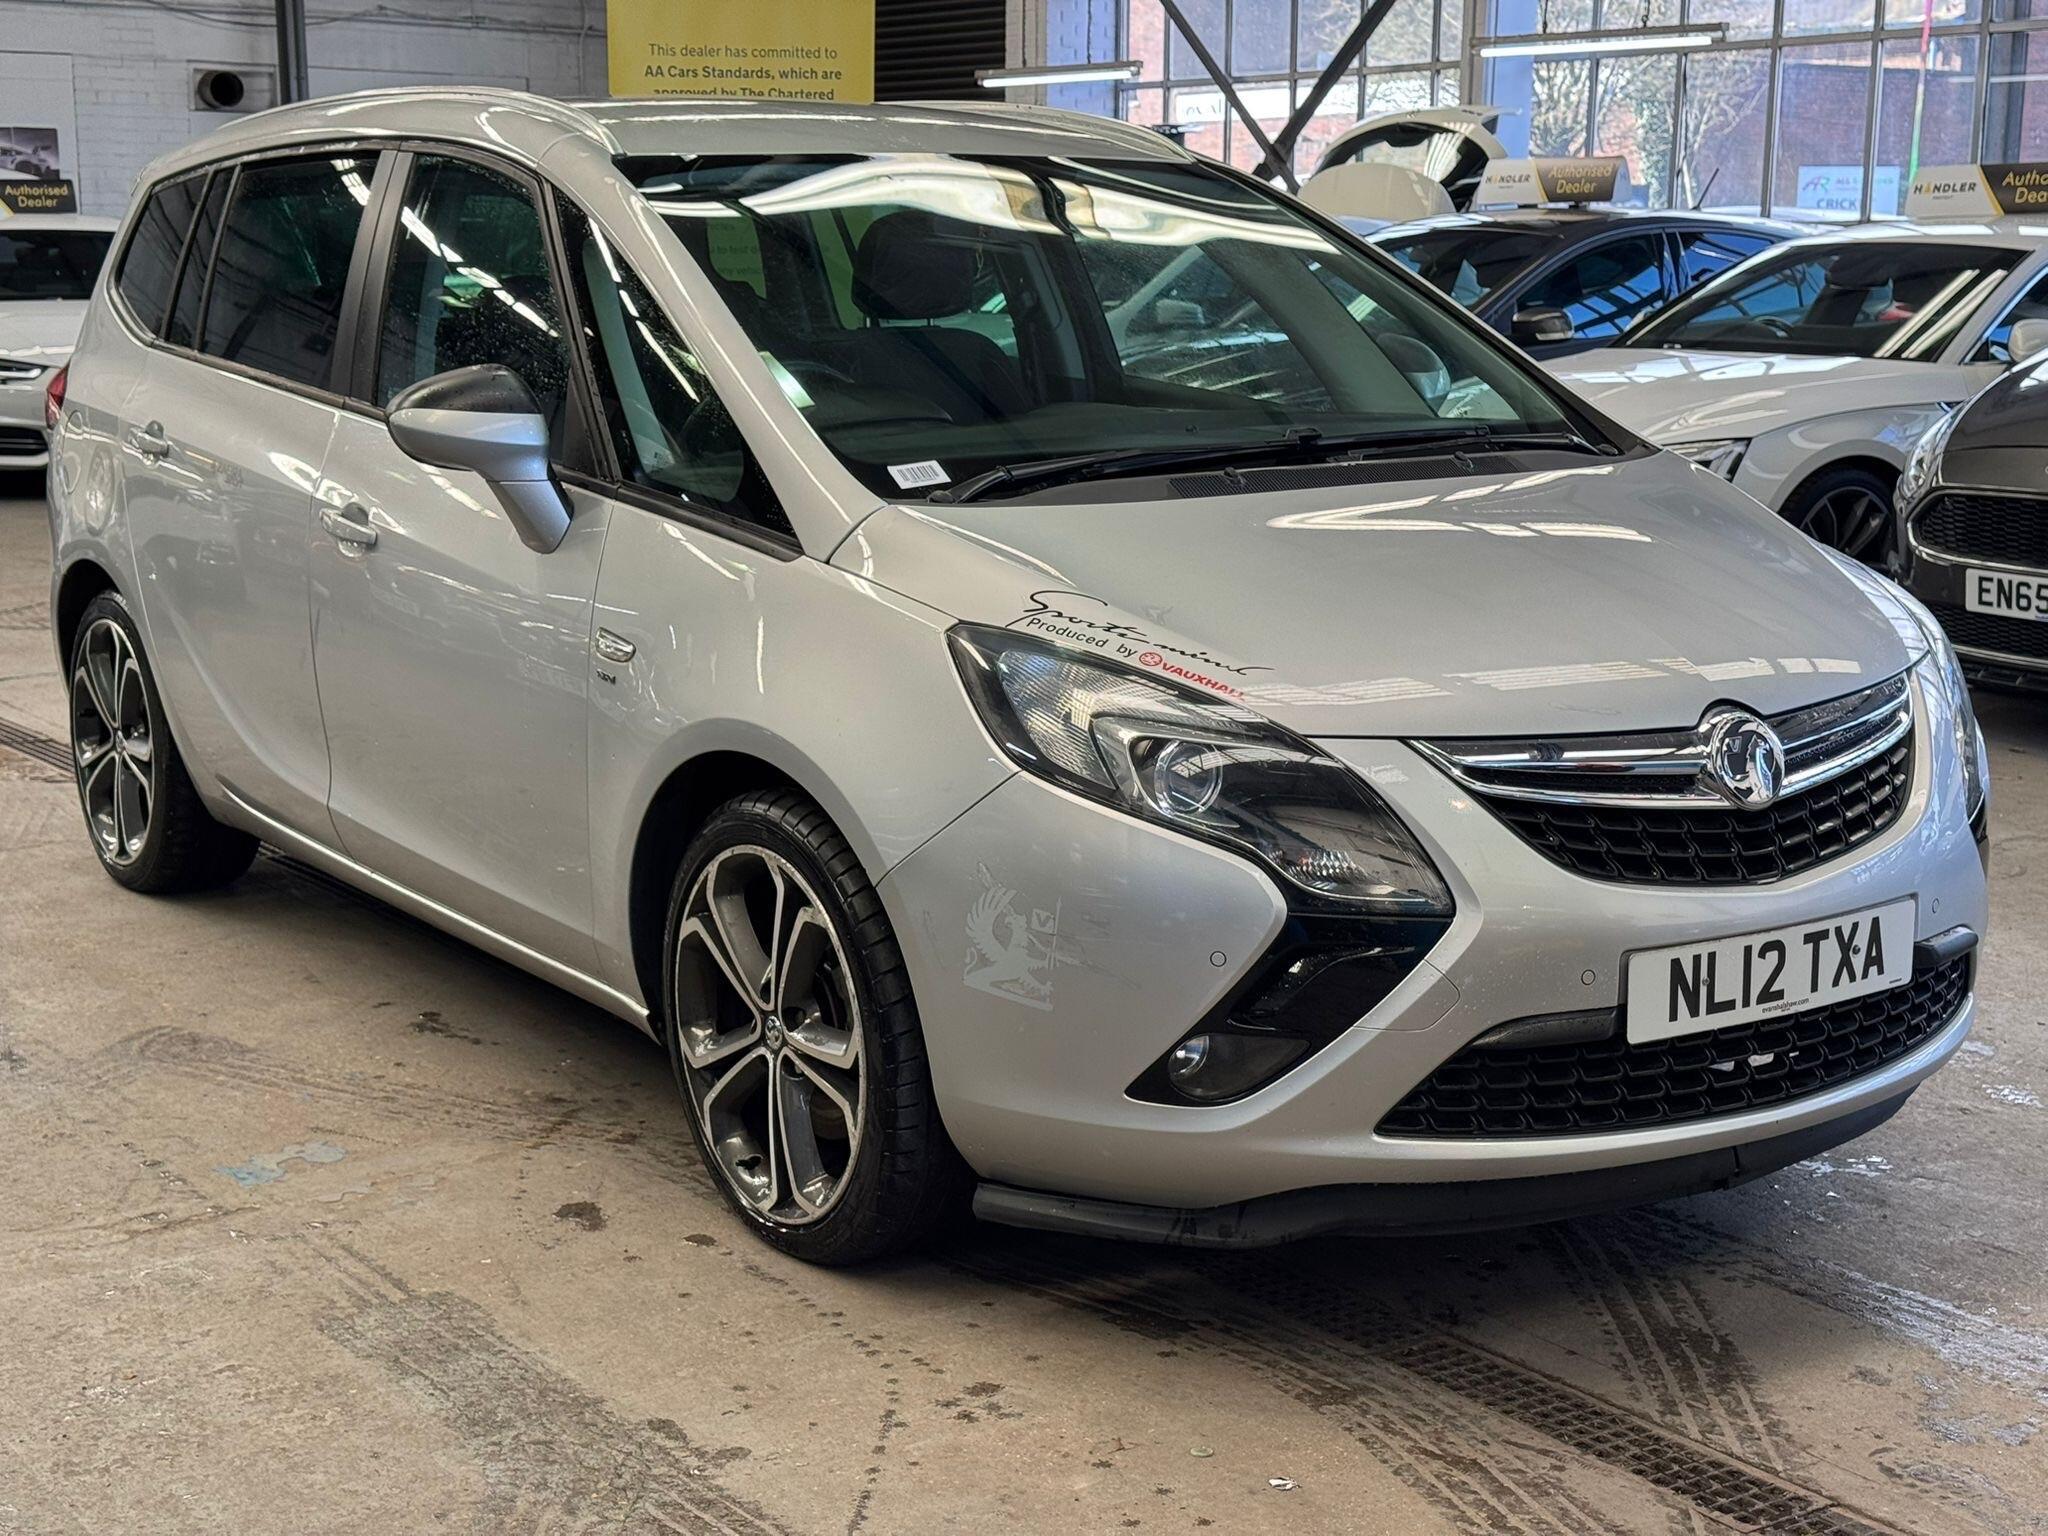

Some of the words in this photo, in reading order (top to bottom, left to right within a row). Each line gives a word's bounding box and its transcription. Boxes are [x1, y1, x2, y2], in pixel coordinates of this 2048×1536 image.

[648, 43, 677, 57] This
[680, 44, 721, 57] dealer
[724, 45, 748, 58] has
[751, 46, 821, 59] committed
[825, 46, 838, 60] to
[644, 65, 665, 77] AA
[668, 65, 699, 78] Cars
[702, 66, 775, 80] Standards,
[778, 67, 818, 79] which
[822, 70, 842, 80] are
[768, 88, 834, 100] Chartered
[1548, 163, 1613, 178] Authorised
[5, 184, 69, 196] Authorised
[1556, 179, 1597, 194] Dealer
[18, 196, 58, 208] Dealer
[1977, 575, 2048, 615] EN65
[1026, 617, 1109, 648] Produced
[1116, 643, 1138, 658] by
[1668, 938, 1787, 1024] NL12
[1802, 915, 1886, 994] TXA
